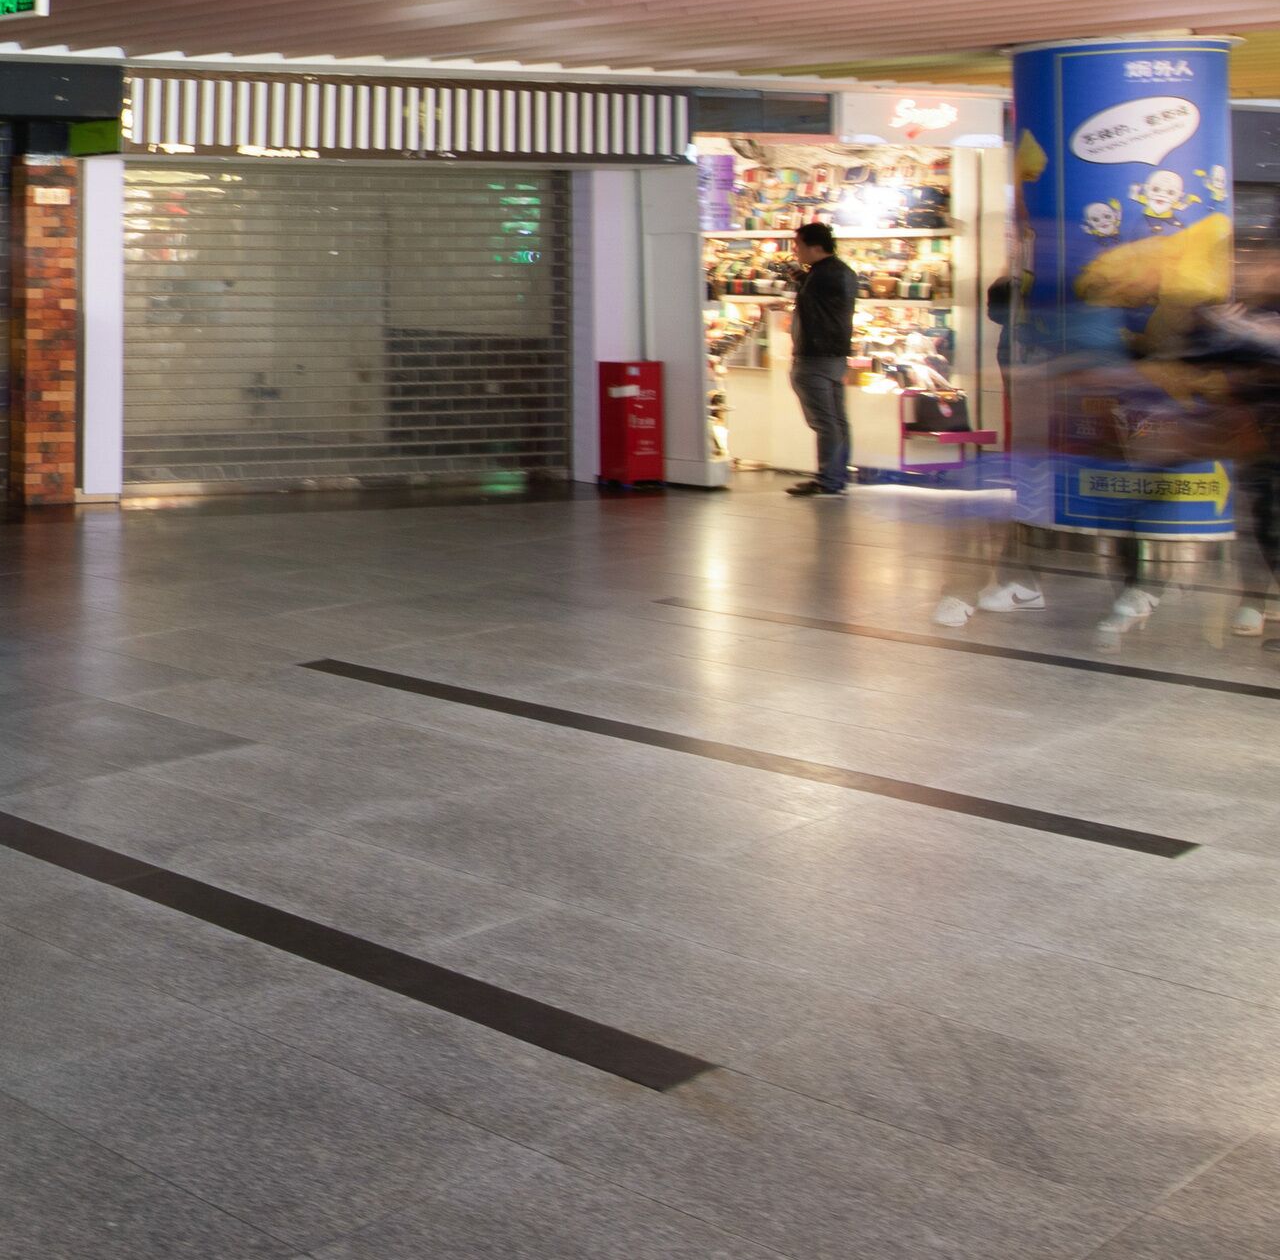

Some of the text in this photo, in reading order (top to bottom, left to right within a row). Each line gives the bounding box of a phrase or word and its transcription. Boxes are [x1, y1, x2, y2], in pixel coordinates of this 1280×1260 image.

[1088, 475, 1221, 497] 通往北京路方向
